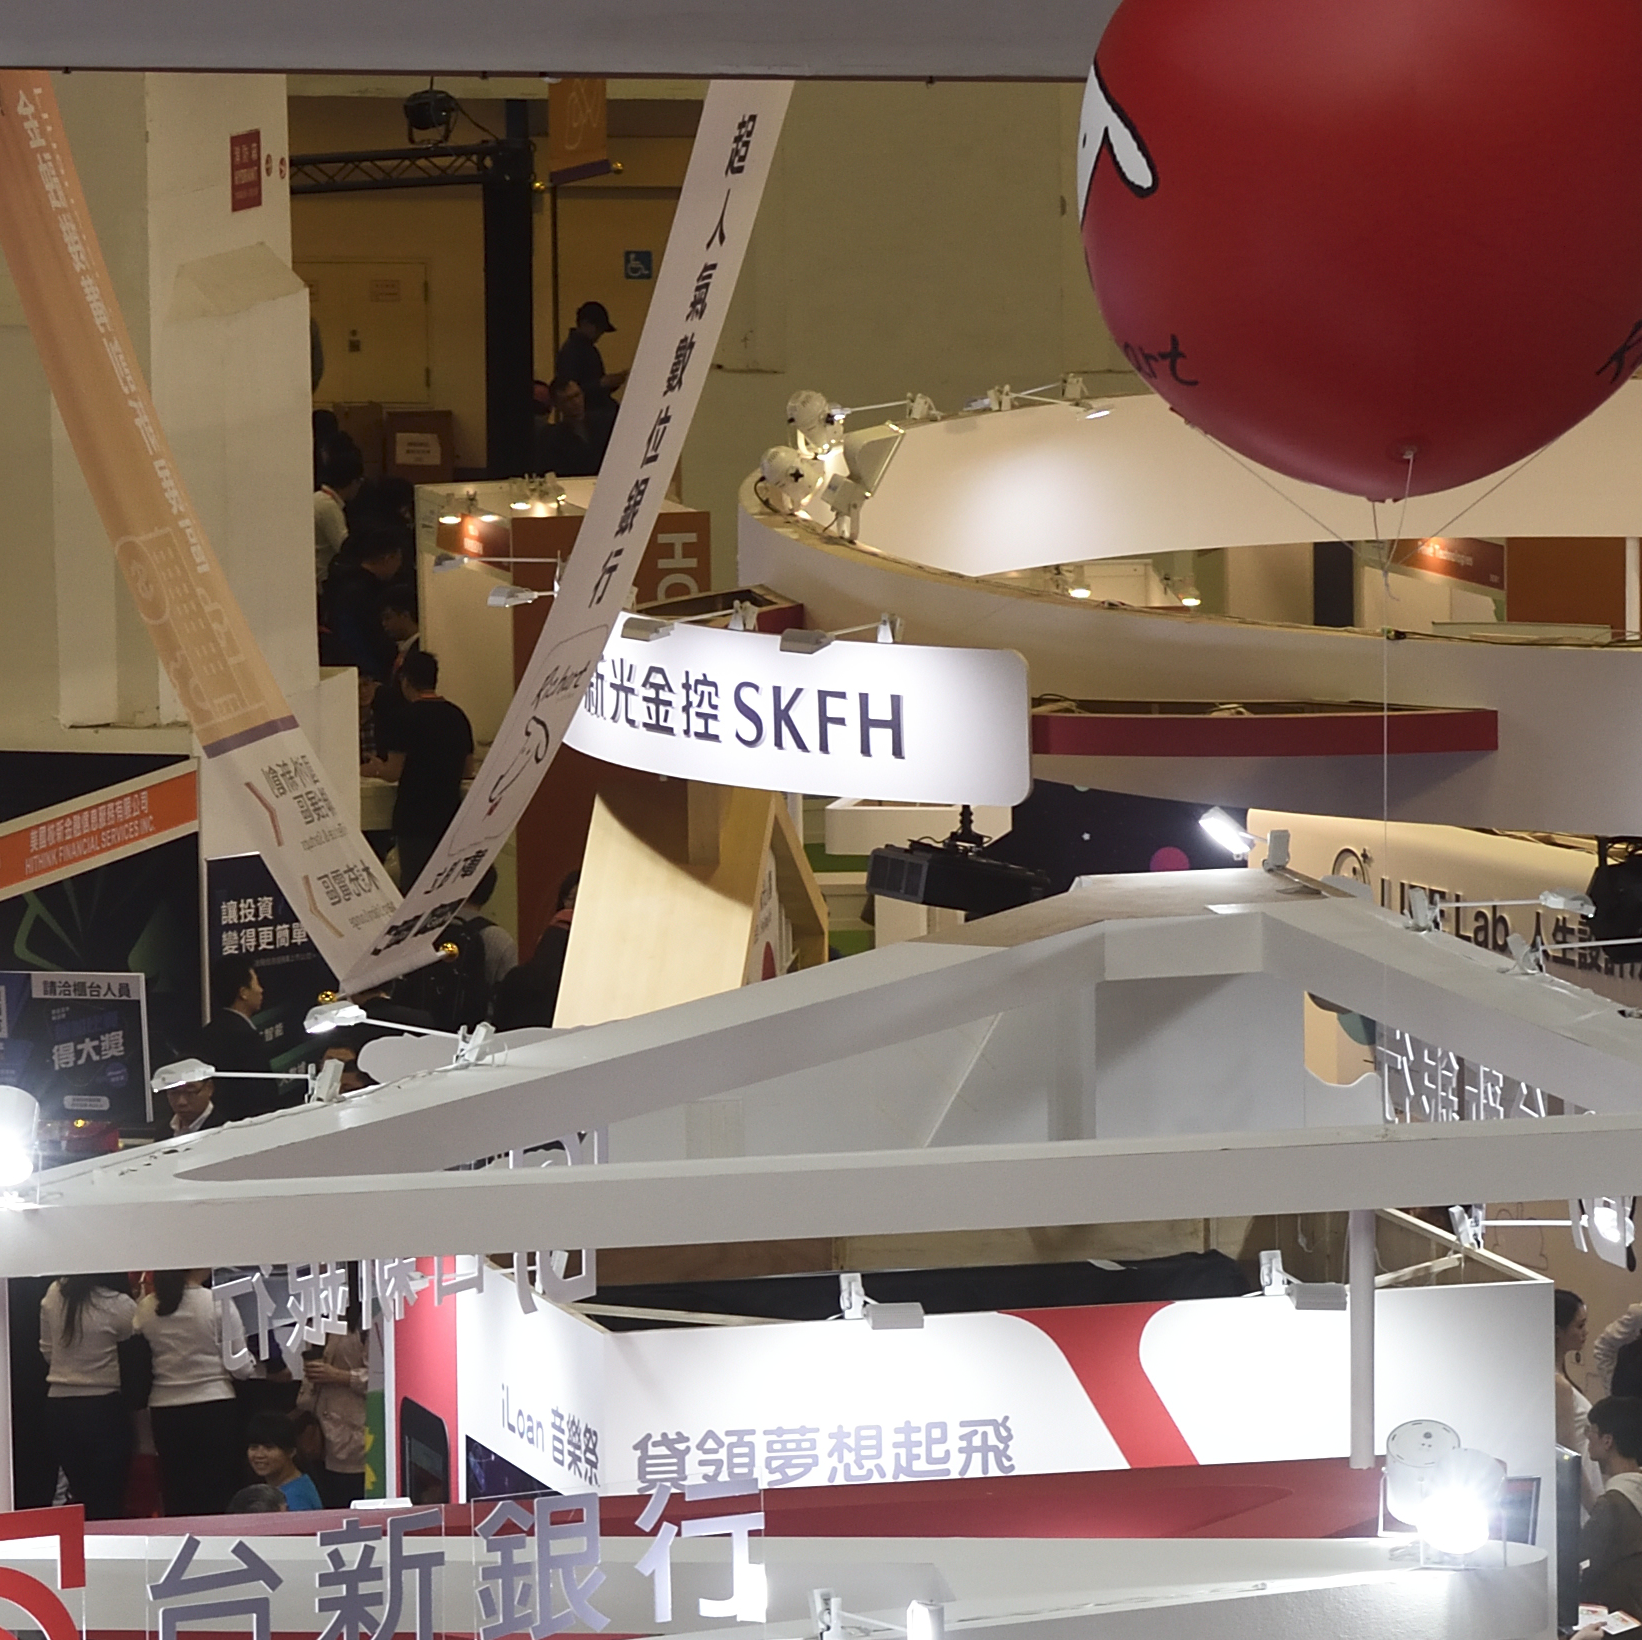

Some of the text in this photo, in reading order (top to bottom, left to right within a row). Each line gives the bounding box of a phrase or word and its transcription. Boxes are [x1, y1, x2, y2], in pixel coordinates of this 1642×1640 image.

[588, 112, 758, 609] 超人氣數位銀行
[733, 679, 907, 760] SKFH
[101, 825, 139, 849] SERVICES
[220, 895, 275, 926] 讓投資
[221, 921, 309, 956] 變得更簡單
[42, 979, 132, 999] 請洽櫃台人員
[51, 1029, 126, 1071] 得大獎
[500, 1383, 546, 1455] iLoan
[549, 1405, 603, 1488] 音樂祭
[632, 1414, 1017, 1495] 貸領夢想起飛
